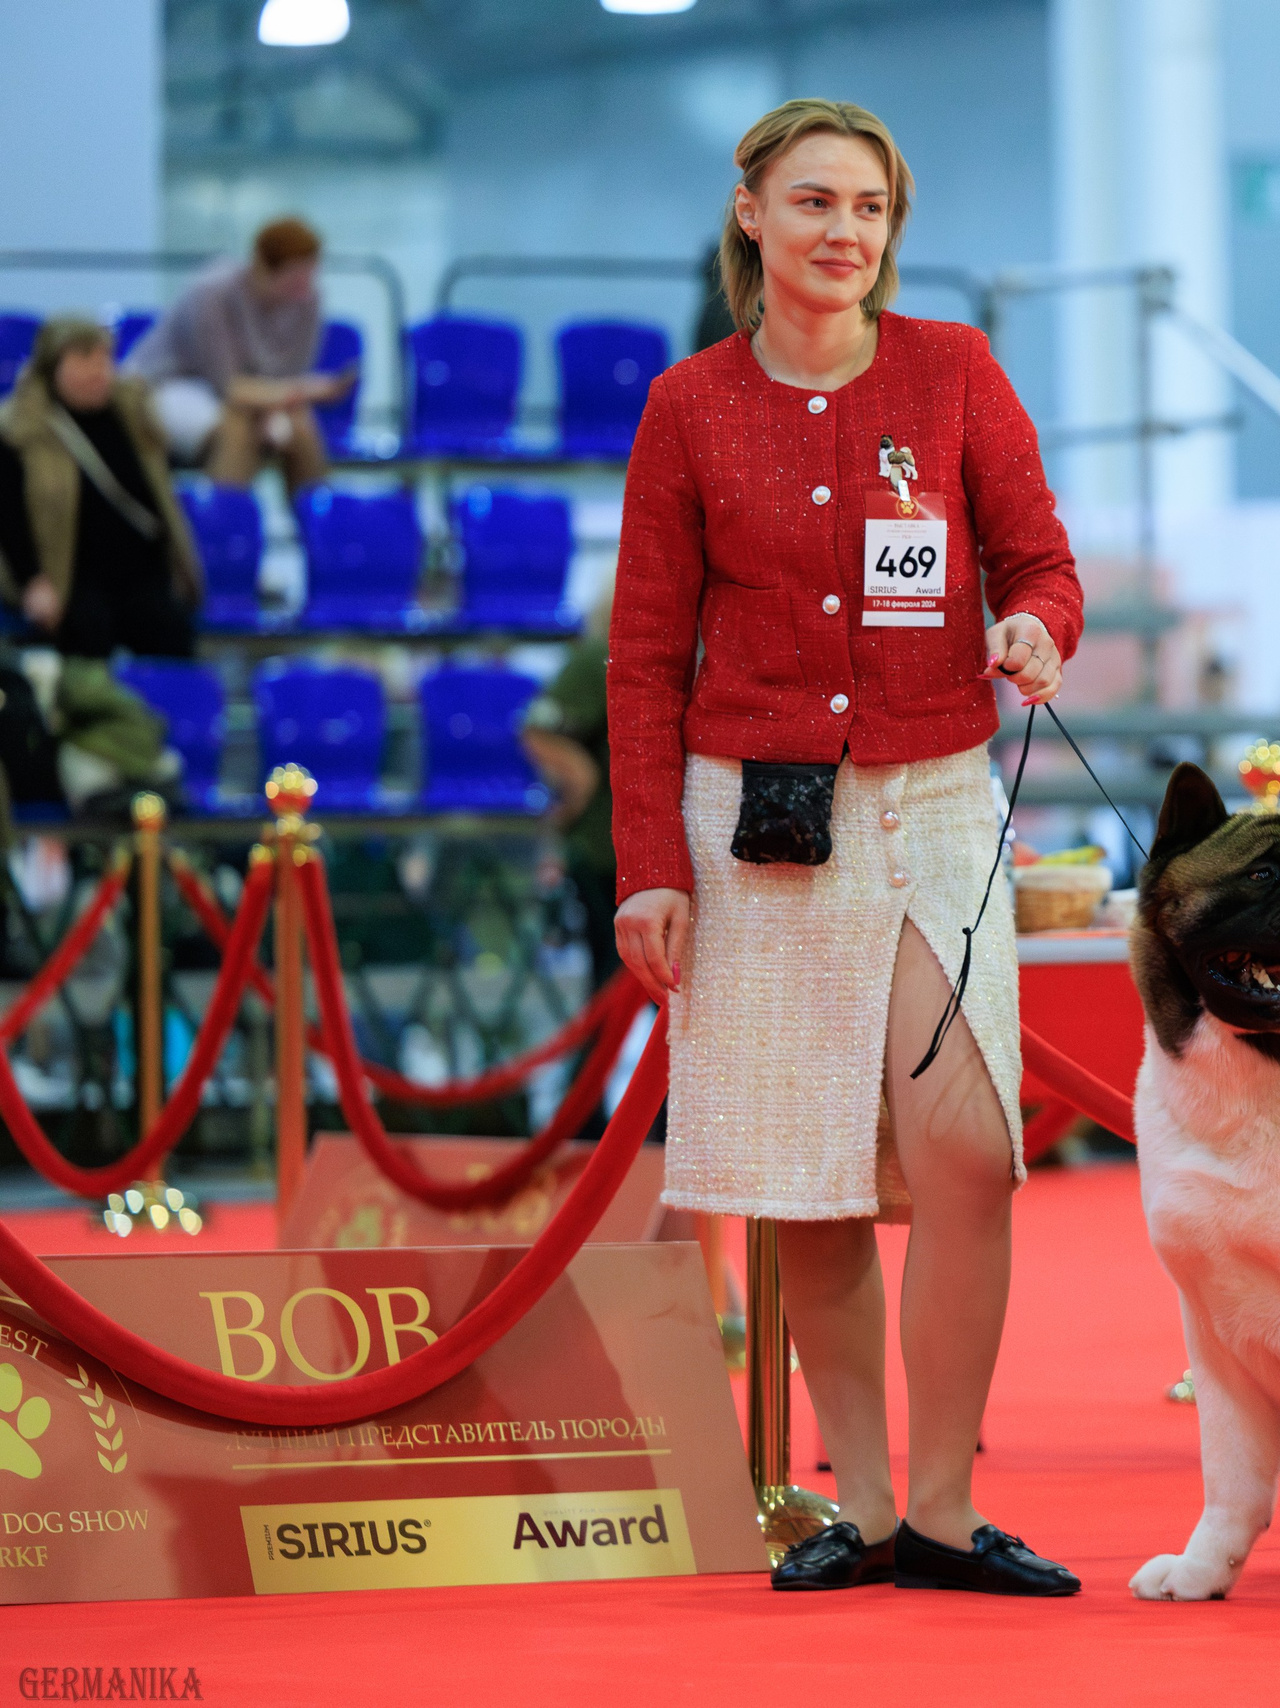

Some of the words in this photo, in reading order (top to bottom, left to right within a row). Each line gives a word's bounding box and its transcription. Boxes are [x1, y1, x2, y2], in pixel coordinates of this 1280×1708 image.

[875, 545, 937, 578] 469
[869, 586, 898, 594] SIRIUS
[915, 586, 942, 594] Award
[872, 600, 891, 608] 17-18
[891, 600, 921, 609] февраля
[921, 600, 936, 608] 2024
[0, 1324, 48, 1361] EST
[199, 1286, 440, 1382] BOB
[346, 1419, 555, 1450] ПРЕДСТАВИТЕЛЬ
[558, 1416, 667, 1441] ПОРОДЫ
[1, 1511, 64, 1535] DOG
[68, 1508, 149, 1533] SHOW
[513, 1503, 669, 1550] Award
